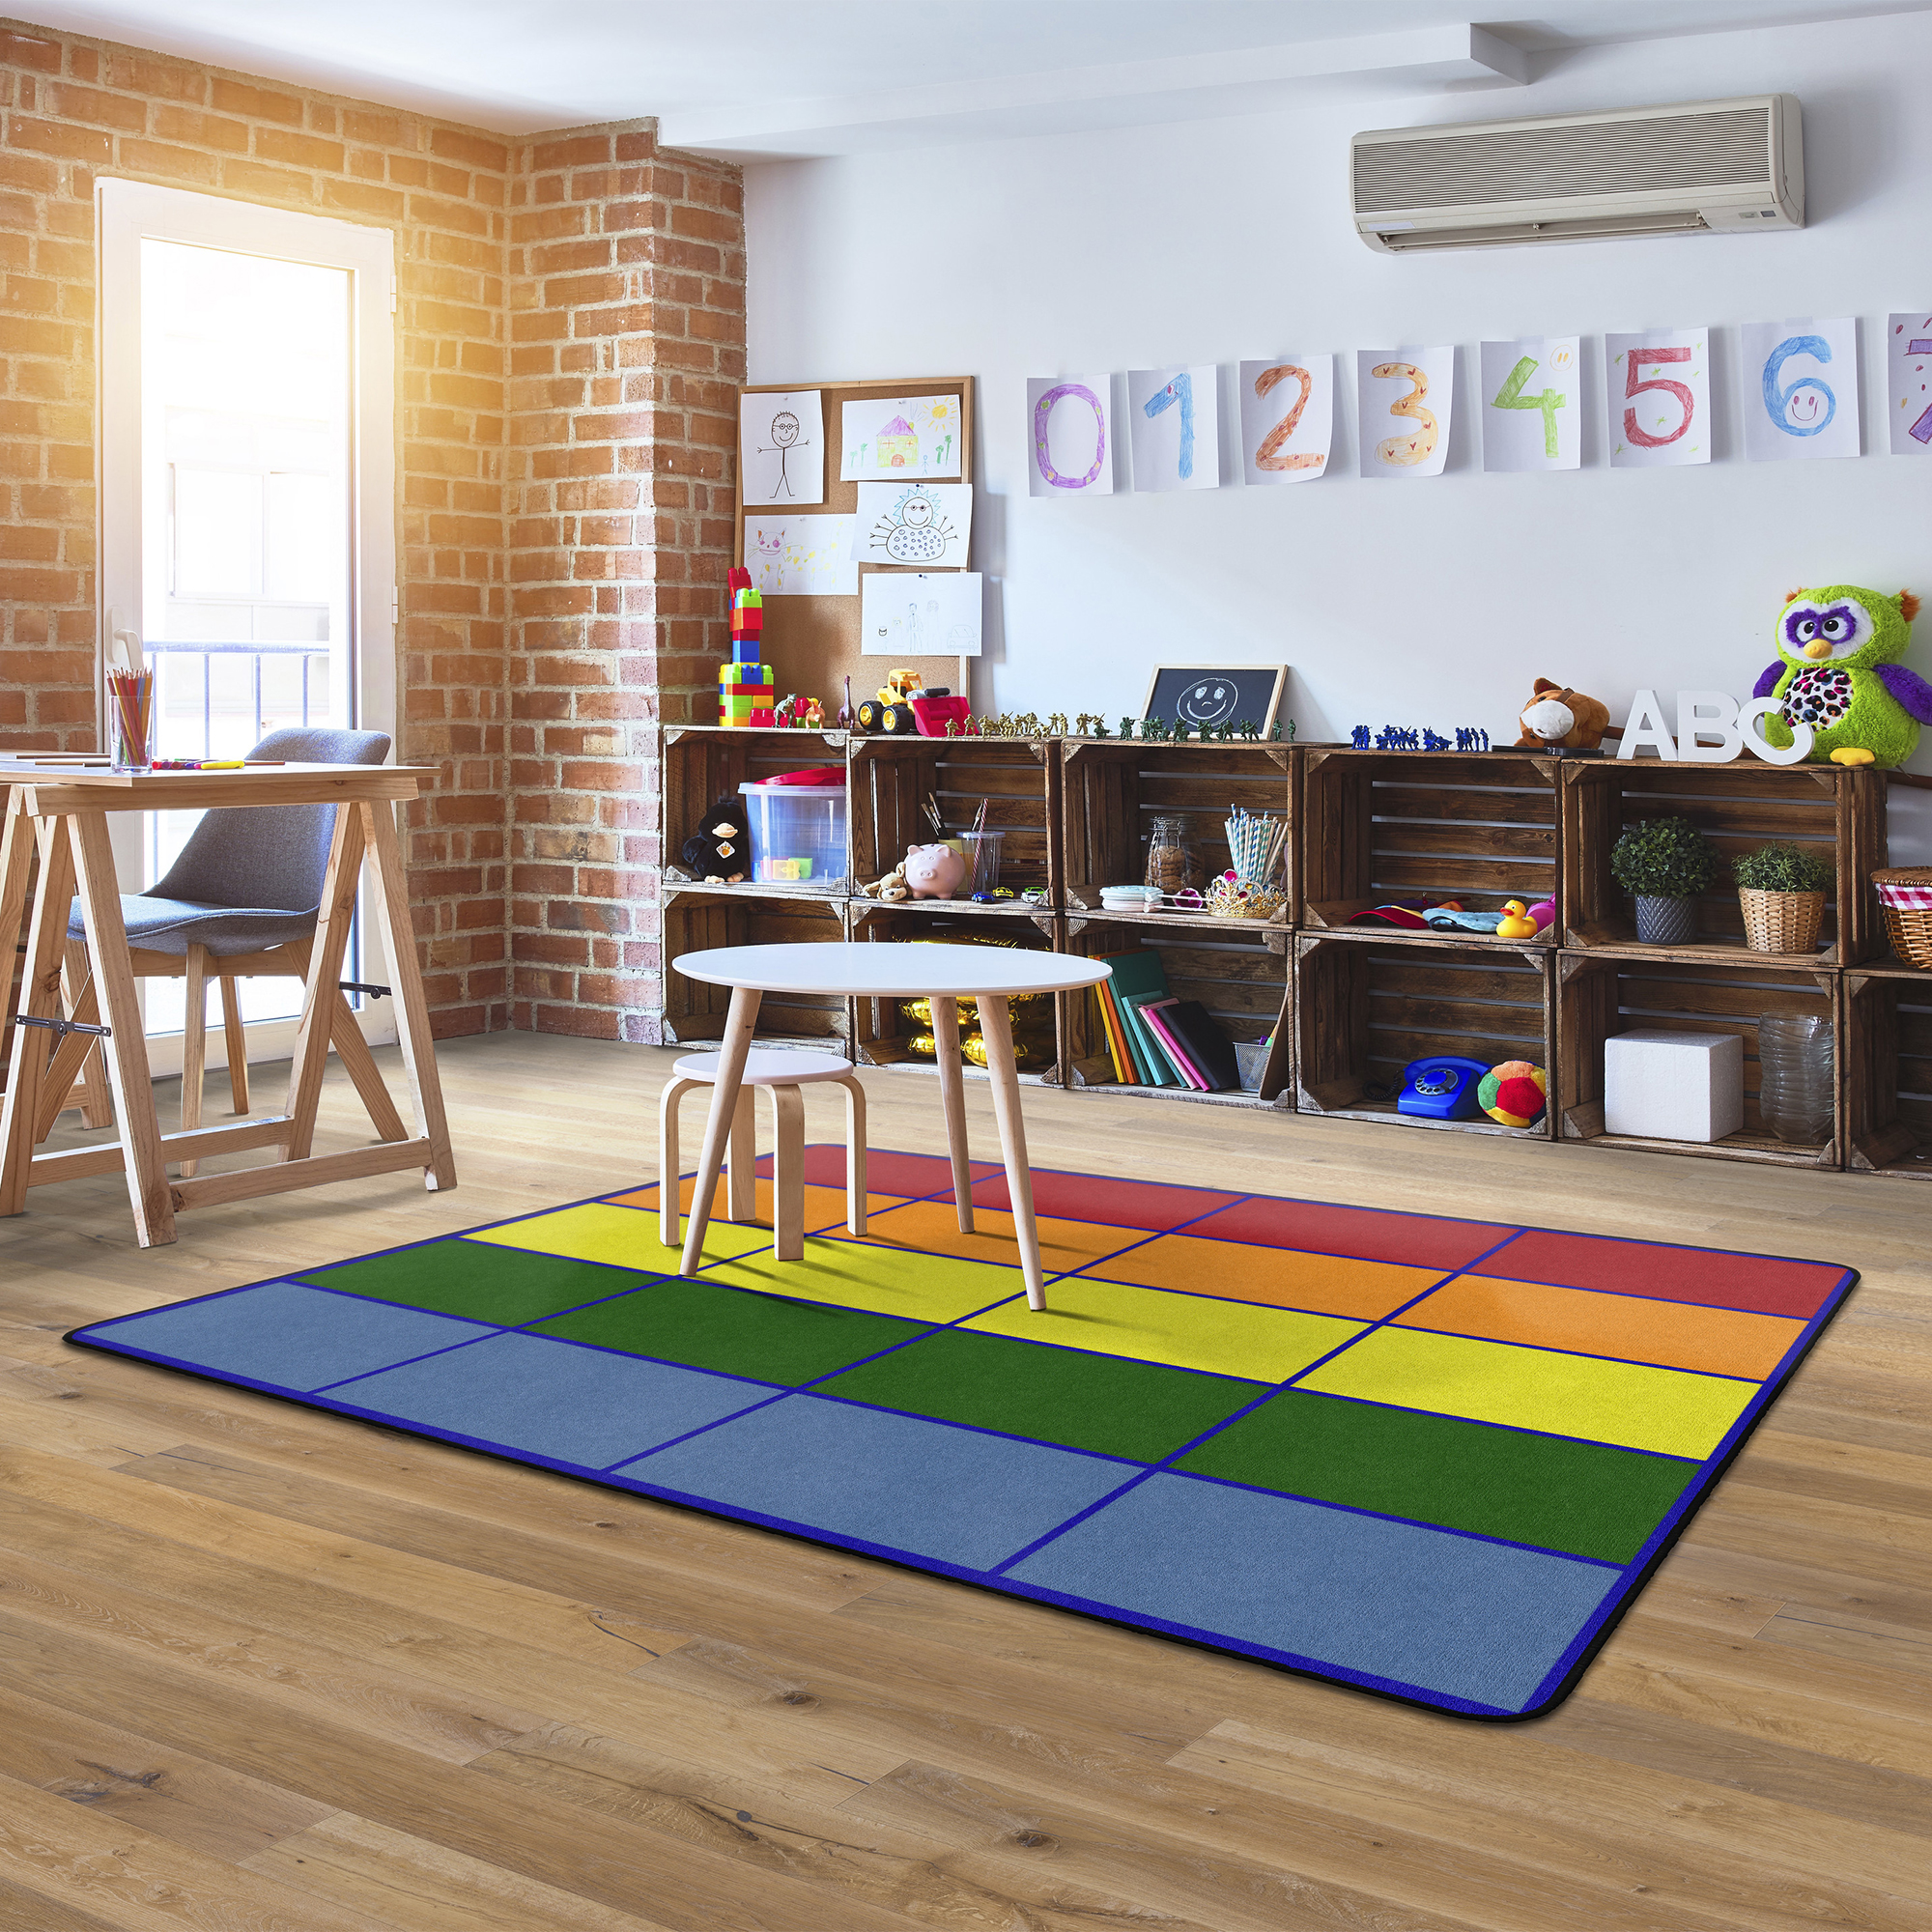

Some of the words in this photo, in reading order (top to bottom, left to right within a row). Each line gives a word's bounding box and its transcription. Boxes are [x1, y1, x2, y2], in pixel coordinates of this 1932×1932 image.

[1035, 384, 1105, 489] 0
[1143, 372, 1196, 481] 1
[1255, 364, 1325, 472] 2
[1372, 362, 1439, 467] 3
[1491, 355, 1567, 458] 4
[1623, 347, 1695, 449] 5
[1762, 334, 1836, 437] 6
[1616, 689, 1815, 766] ABC
